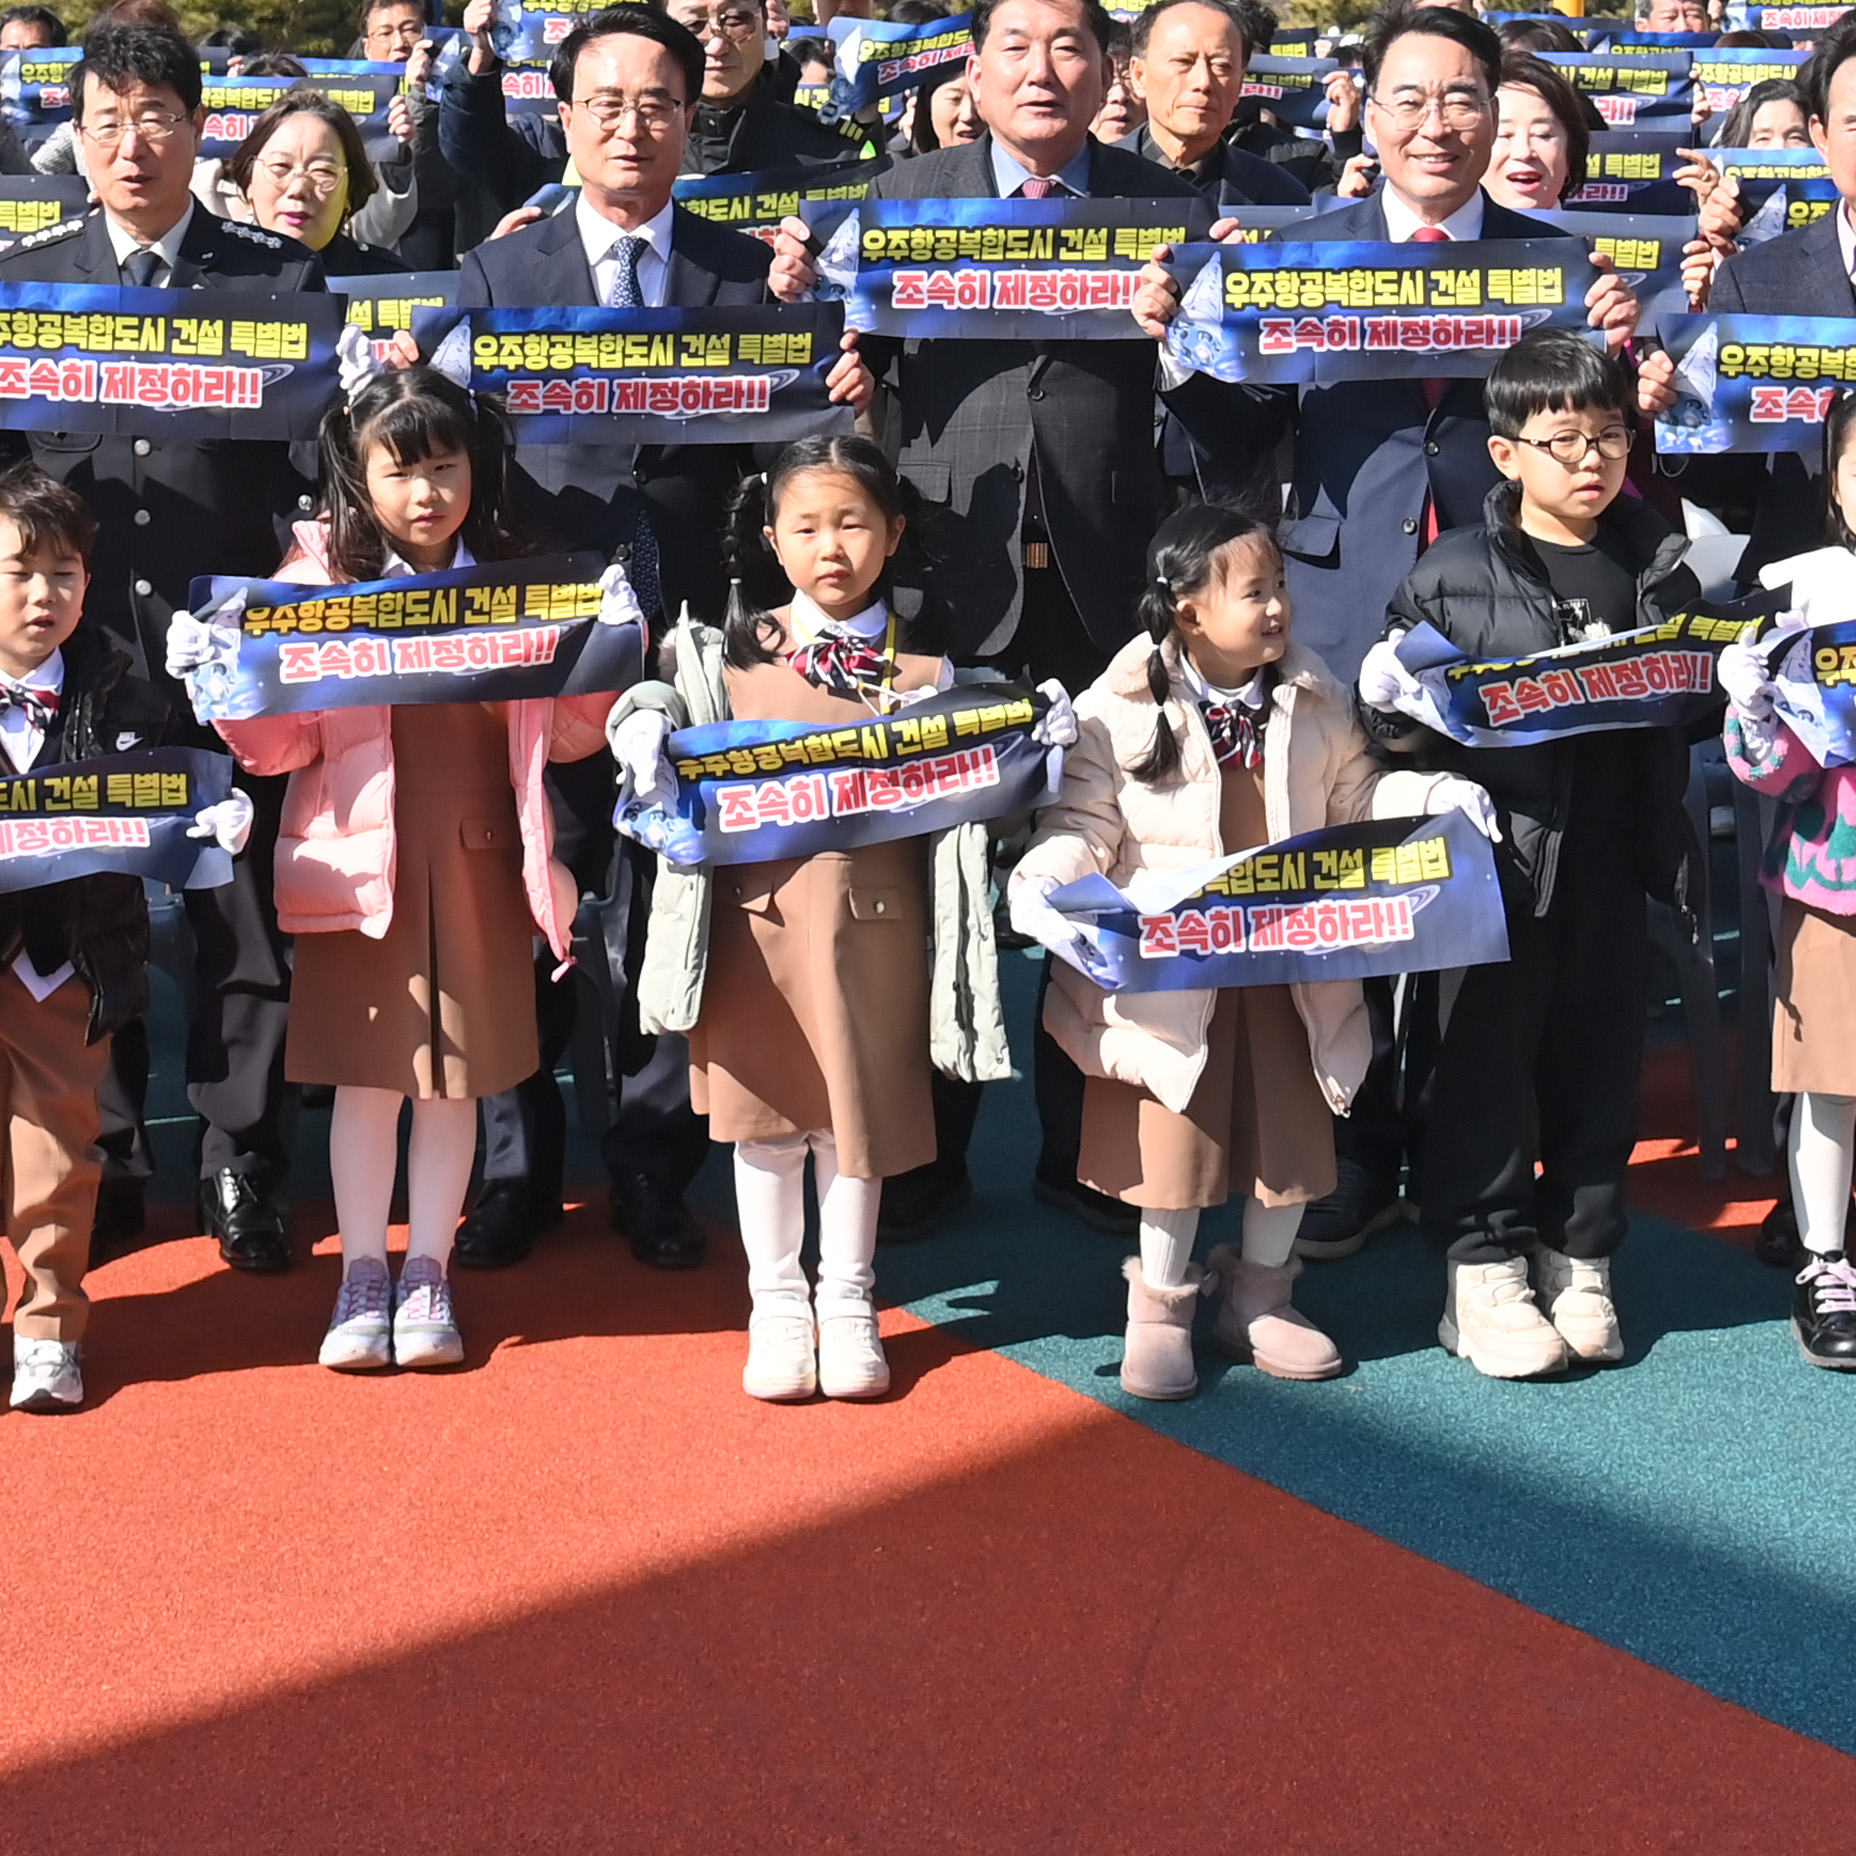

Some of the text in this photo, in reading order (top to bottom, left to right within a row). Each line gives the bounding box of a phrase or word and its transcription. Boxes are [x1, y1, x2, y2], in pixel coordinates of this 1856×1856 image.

[1606, 154, 1661, 179] 특별법
[863, 227, 1054, 261] 우주항공복합도시
[1060, 227, 1109, 261] 건설
[895, 272, 988, 306] 조속히
[1226, 268, 1563, 309] 우주항공복합도시 건설 특별법
[347, 300, 374, 332] 설
[1263, 318, 1520, 350] 조속히 제정하라!!
[173, 318, 225, 356] 건설
[231, 320, 308, 360] 특별법
[474, 332, 813, 371] 우주항공복합도시 건설 특별법
[103, 366, 259, 405] 제정하라!!
[511, 379, 768, 411] 조속히 제정하라!!
[245, 583, 604, 636] 우주항공복합도시 건설 특별법
[284, 629, 558, 679] 조속히 제정하라!!
[1482, 680, 1577, 723] 조속히
[1580, 654, 1711, 699] 제정하라!!
[894, 716, 949, 756] 건설
[45, 775, 99, 811] 건설
[108, 773, 188, 808] 특별법
[722, 747, 995, 828] 조속히 제정하라!!
[1313, 837, 1451, 890] 건설 특별법
[1142, 901, 1409, 953] 조속히 제정하라!!
